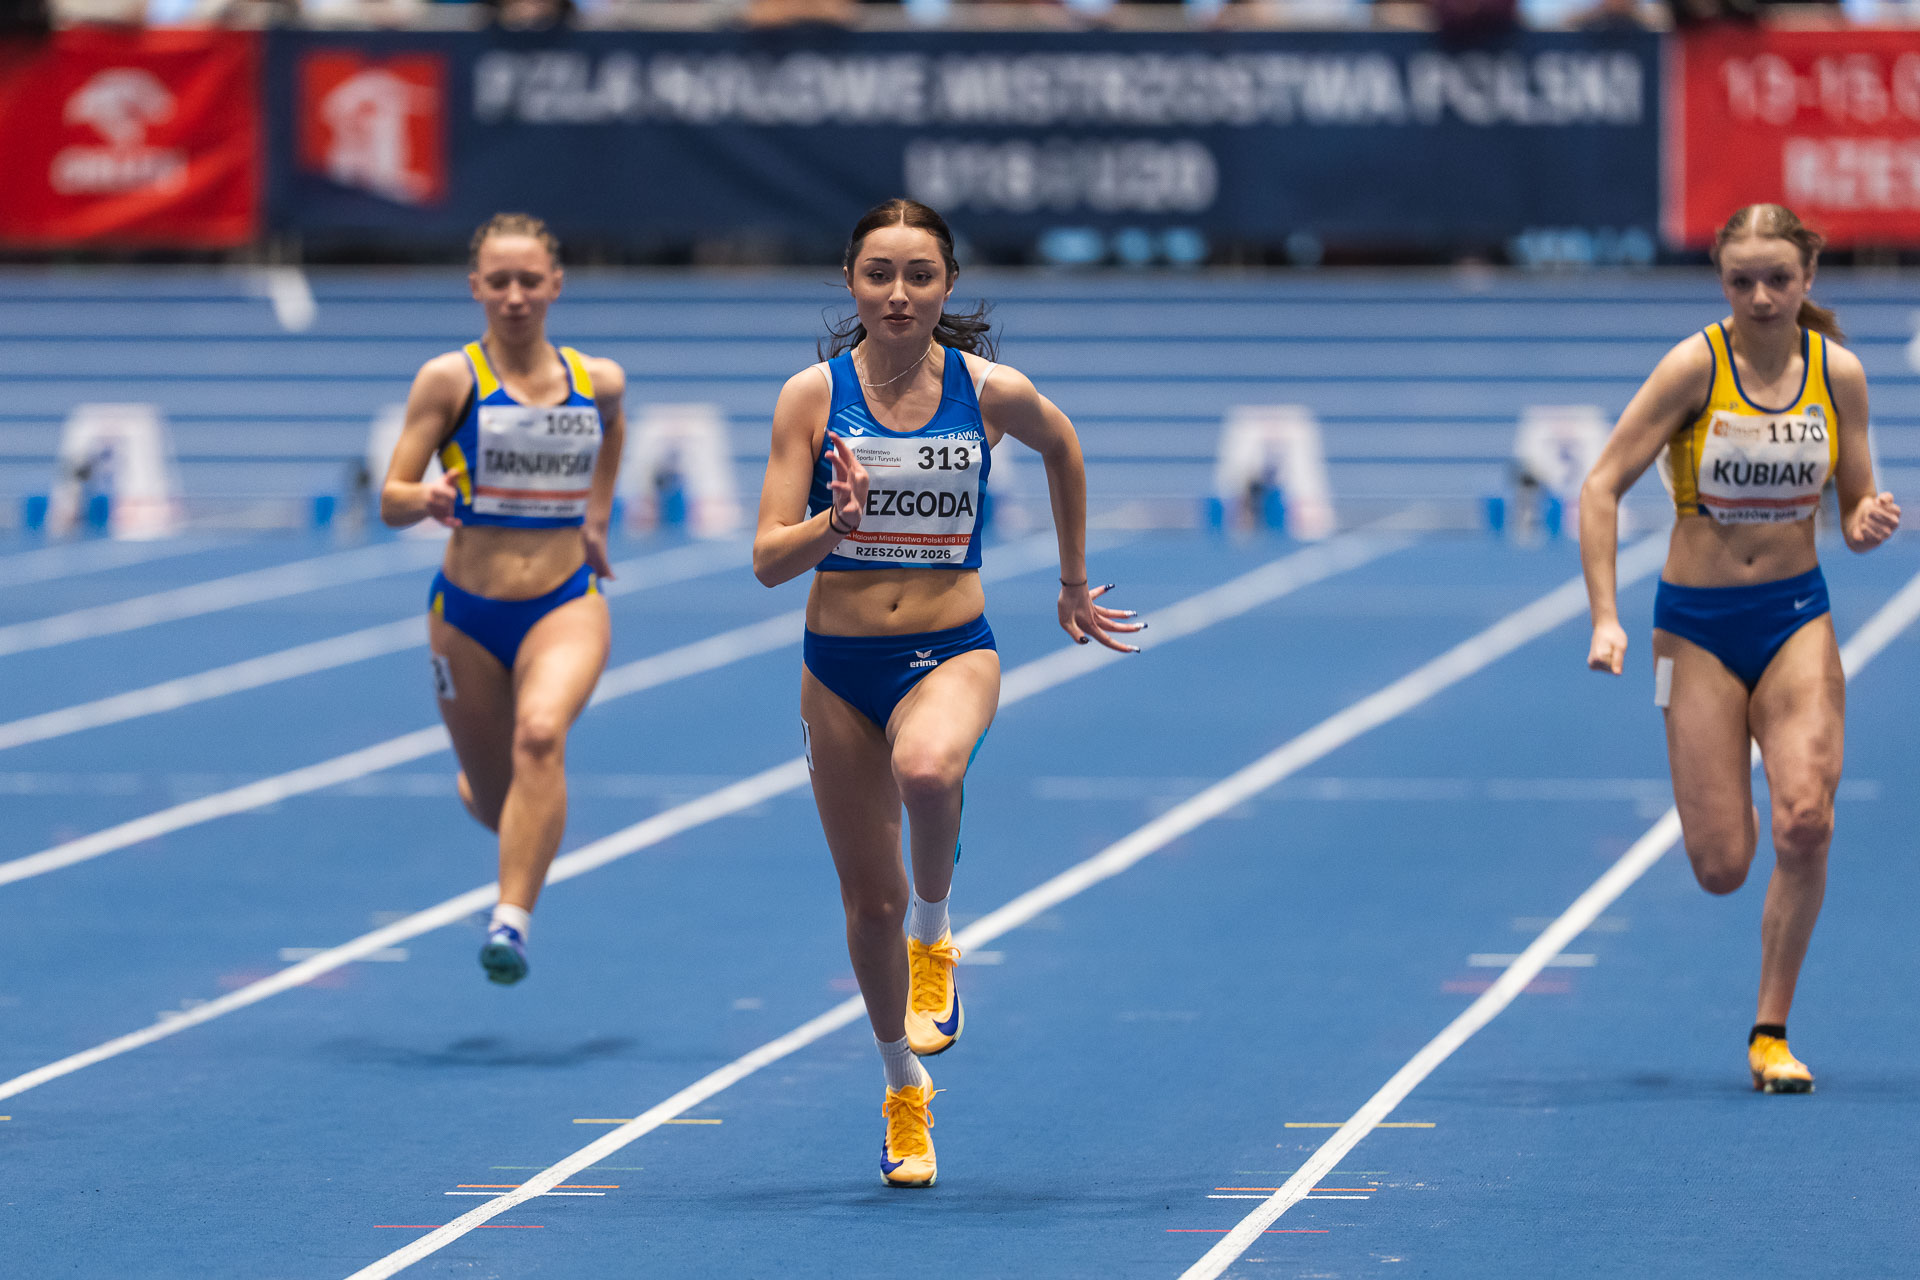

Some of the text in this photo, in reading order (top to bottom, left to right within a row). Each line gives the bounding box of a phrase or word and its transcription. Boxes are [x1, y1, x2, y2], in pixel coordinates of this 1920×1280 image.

[948, 430, 980, 440] RAWA
[1769, 421, 1823, 442] 1170
[918, 446, 970, 470] 313
[1713, 459, 1816, 486] KUBIAK
[866, 490, 973, 517] EZGODA
[853, 533, 877, 541] Halowe
[879, 535, 922, 543] Mistrzostwa
[856, 546, 951, 559] RZESZÓW 2026
[910, 659, 938, 668] erima
